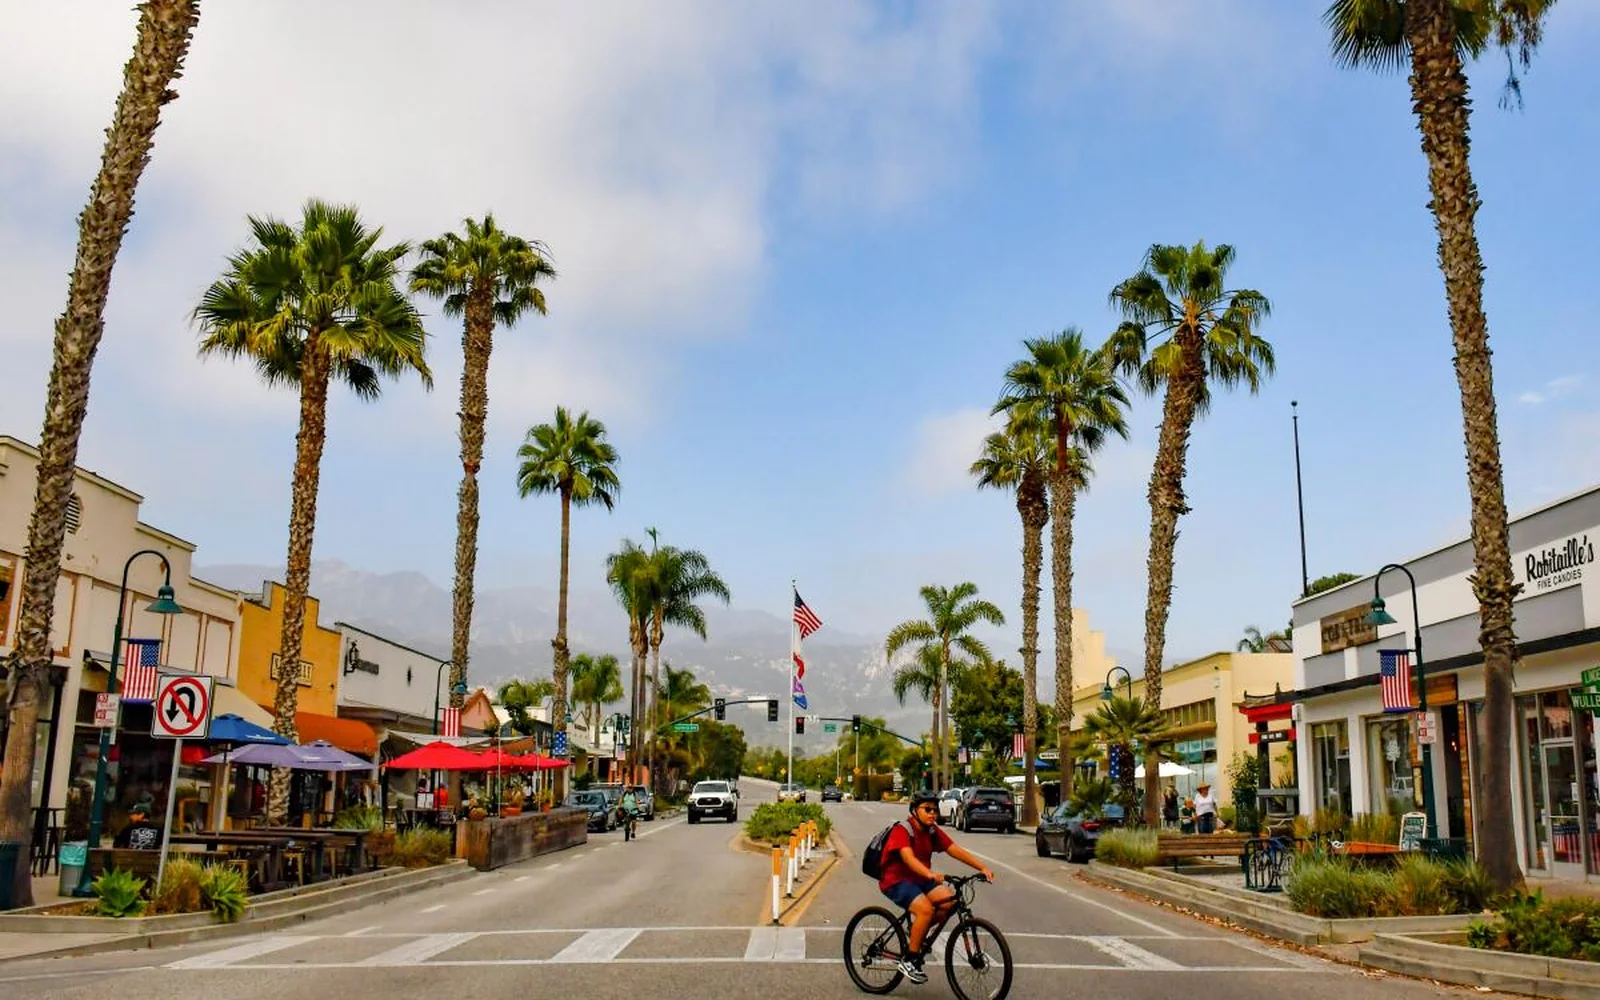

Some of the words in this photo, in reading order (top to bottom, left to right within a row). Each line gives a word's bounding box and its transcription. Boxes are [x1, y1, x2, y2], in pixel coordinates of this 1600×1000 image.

[1525, 534, 1594, 582] Robitaille's
[1537, 577, 1552, 589] FINE
[1553, 568, 1582, 586] CANDIES
